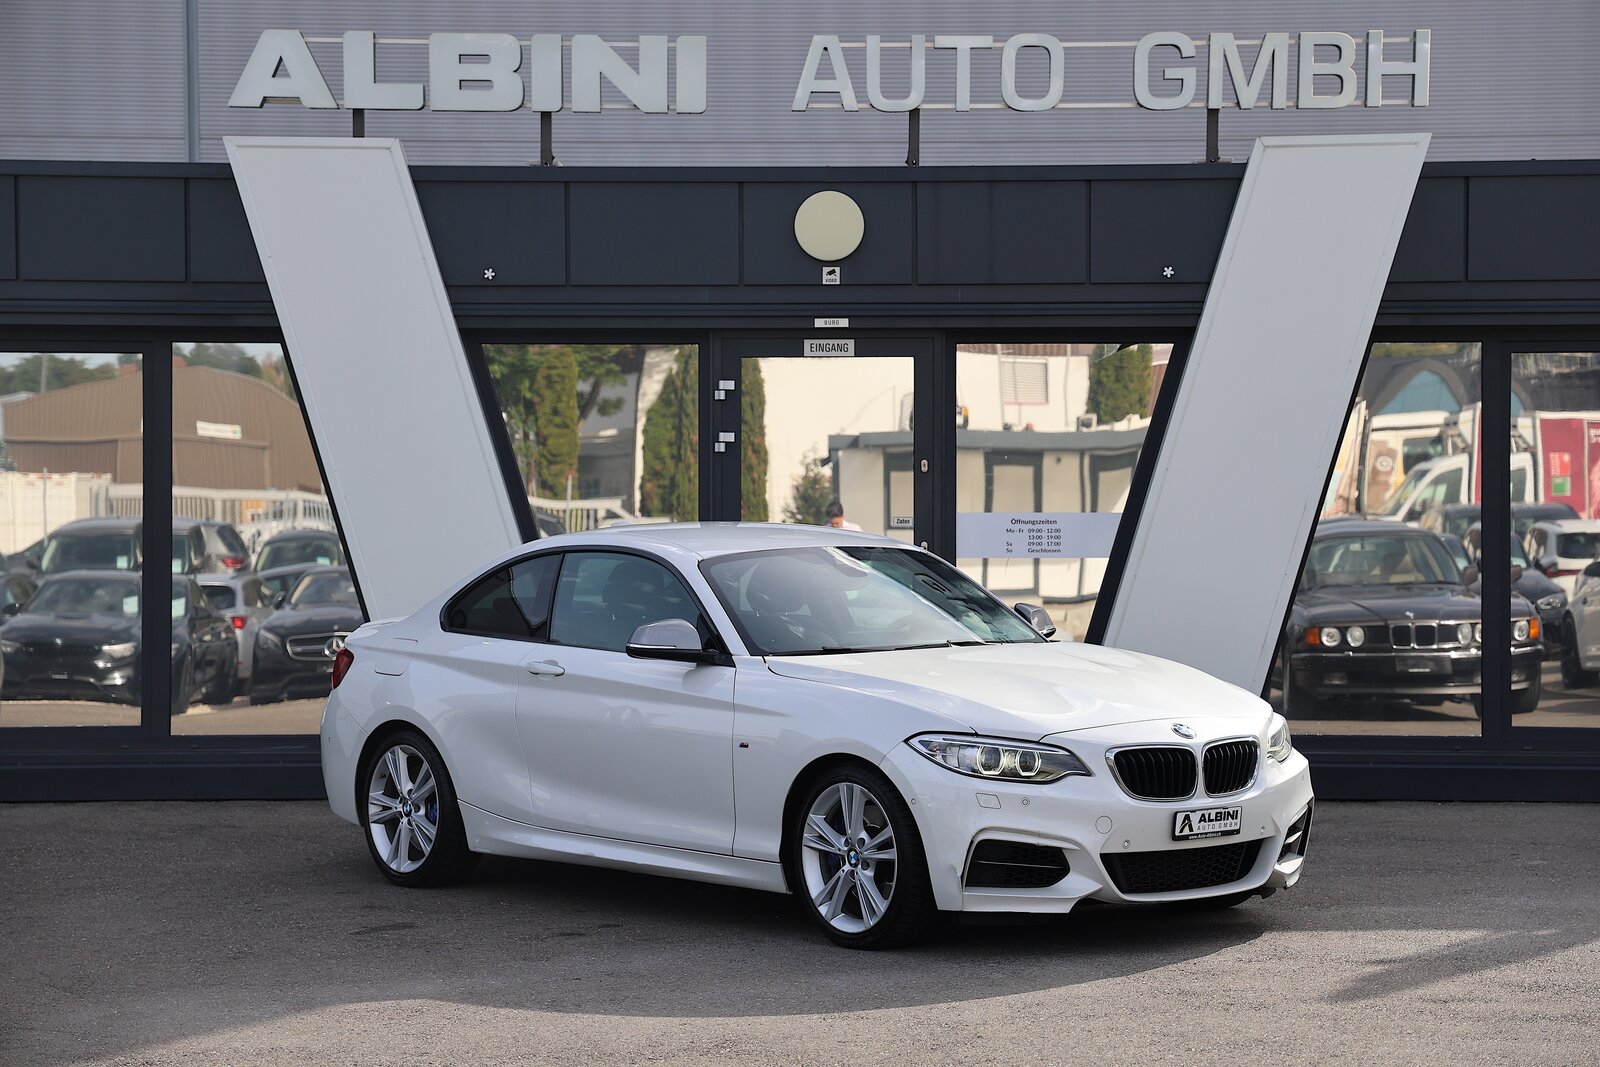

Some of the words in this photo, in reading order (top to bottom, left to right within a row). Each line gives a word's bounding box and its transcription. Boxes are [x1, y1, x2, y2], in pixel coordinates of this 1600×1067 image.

[228, 29, 708, 114] ALBINI
[791, 33, 1065, 113] AUTO
[1133, 29, 1432, 110] GMBH
[809, 343, 849, 353] EINGANG
[1198, 810, 1239, 824] ALBINI
[1197, 823, 1216, 831] AUTO
[1218, 821, 1238, 829] GMBH
